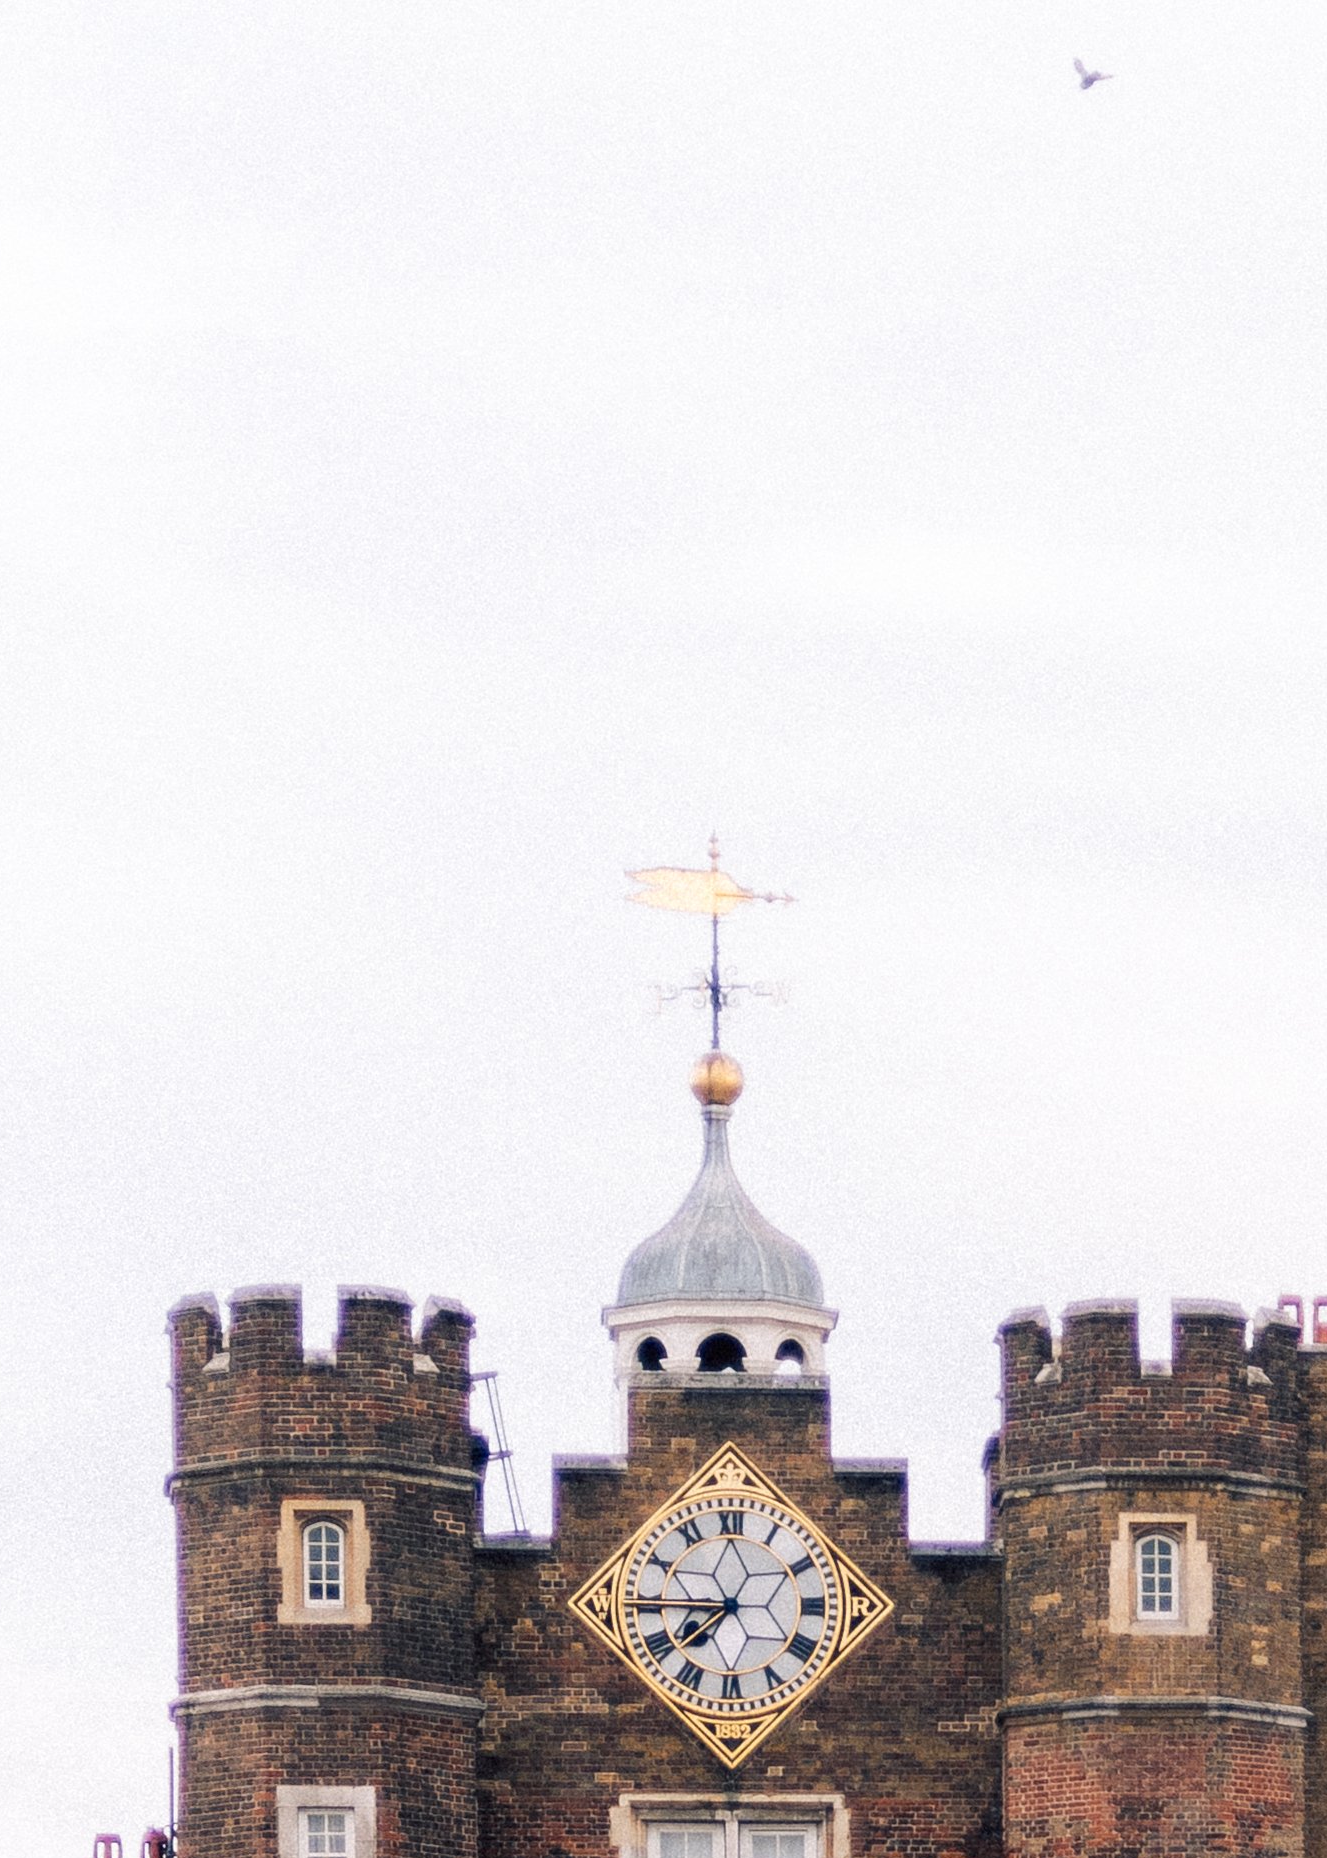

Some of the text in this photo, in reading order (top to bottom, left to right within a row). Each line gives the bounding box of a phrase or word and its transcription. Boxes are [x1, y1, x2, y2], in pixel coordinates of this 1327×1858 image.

[677, 1519, 703, 1548] XI
[719, 1511, 743, 1535] XII
[765, 1523, 780, 1546] I
[851, 1596, 871, 1617] R
